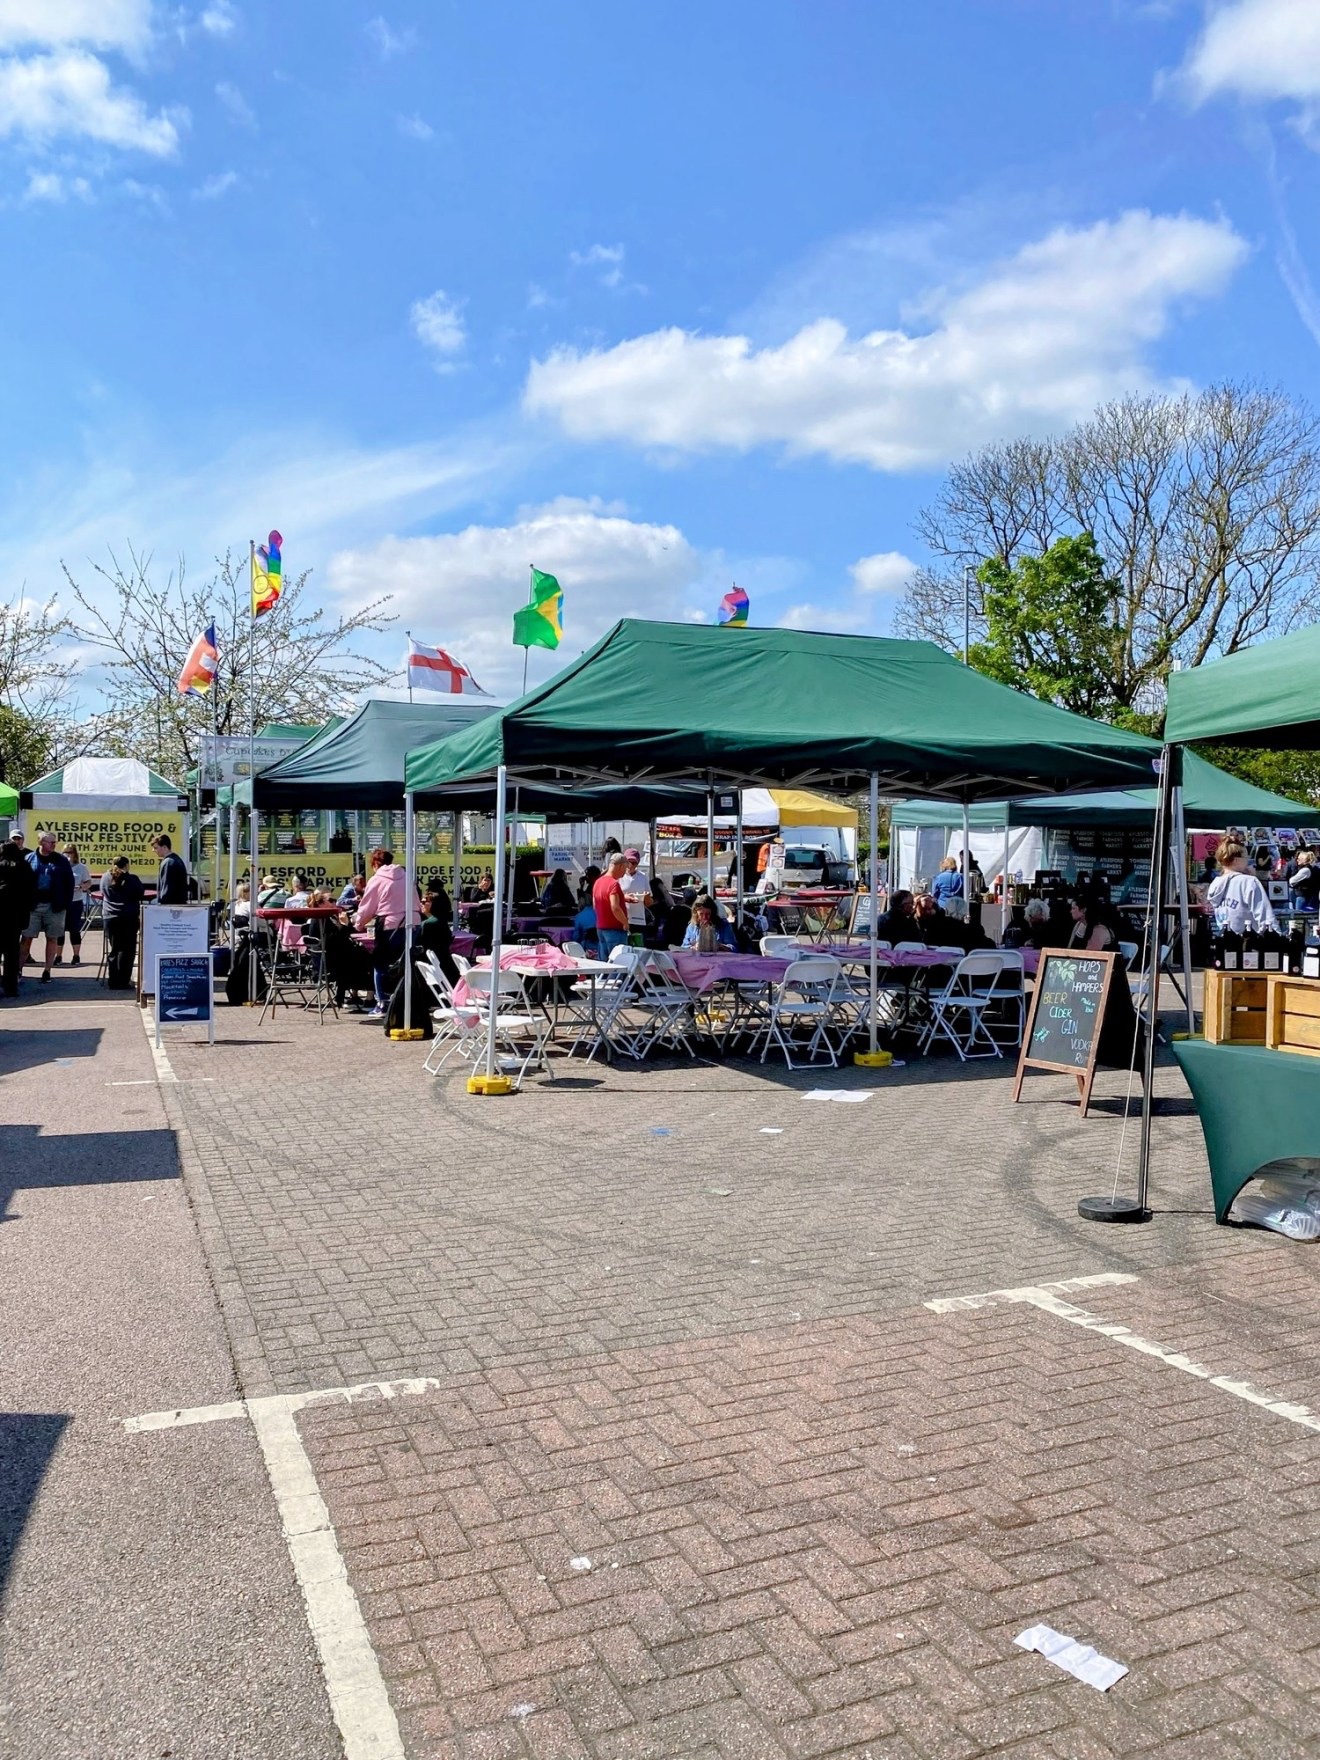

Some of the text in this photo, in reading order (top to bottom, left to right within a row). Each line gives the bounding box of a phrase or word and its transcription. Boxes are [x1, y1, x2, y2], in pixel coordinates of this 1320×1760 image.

[35, 821, 177, 833] AYLESFORD FOOD &
[57, 832, 158, 843] RINK FESTIVA
[94, 844, 118, 852] 29TH
[121, 844, 147, 852] JUNE
[306, 878, 350, 888] ARKET
[1079, 961, 1101, 973] HOPS
[1072, 982, 1104, 993] HAMPERS
[1043, 992, 1067, 1004] BEER
[1049, 1005, 1073, 1018] CIDER
[1061, 1018, 1079, 1035] GIN
